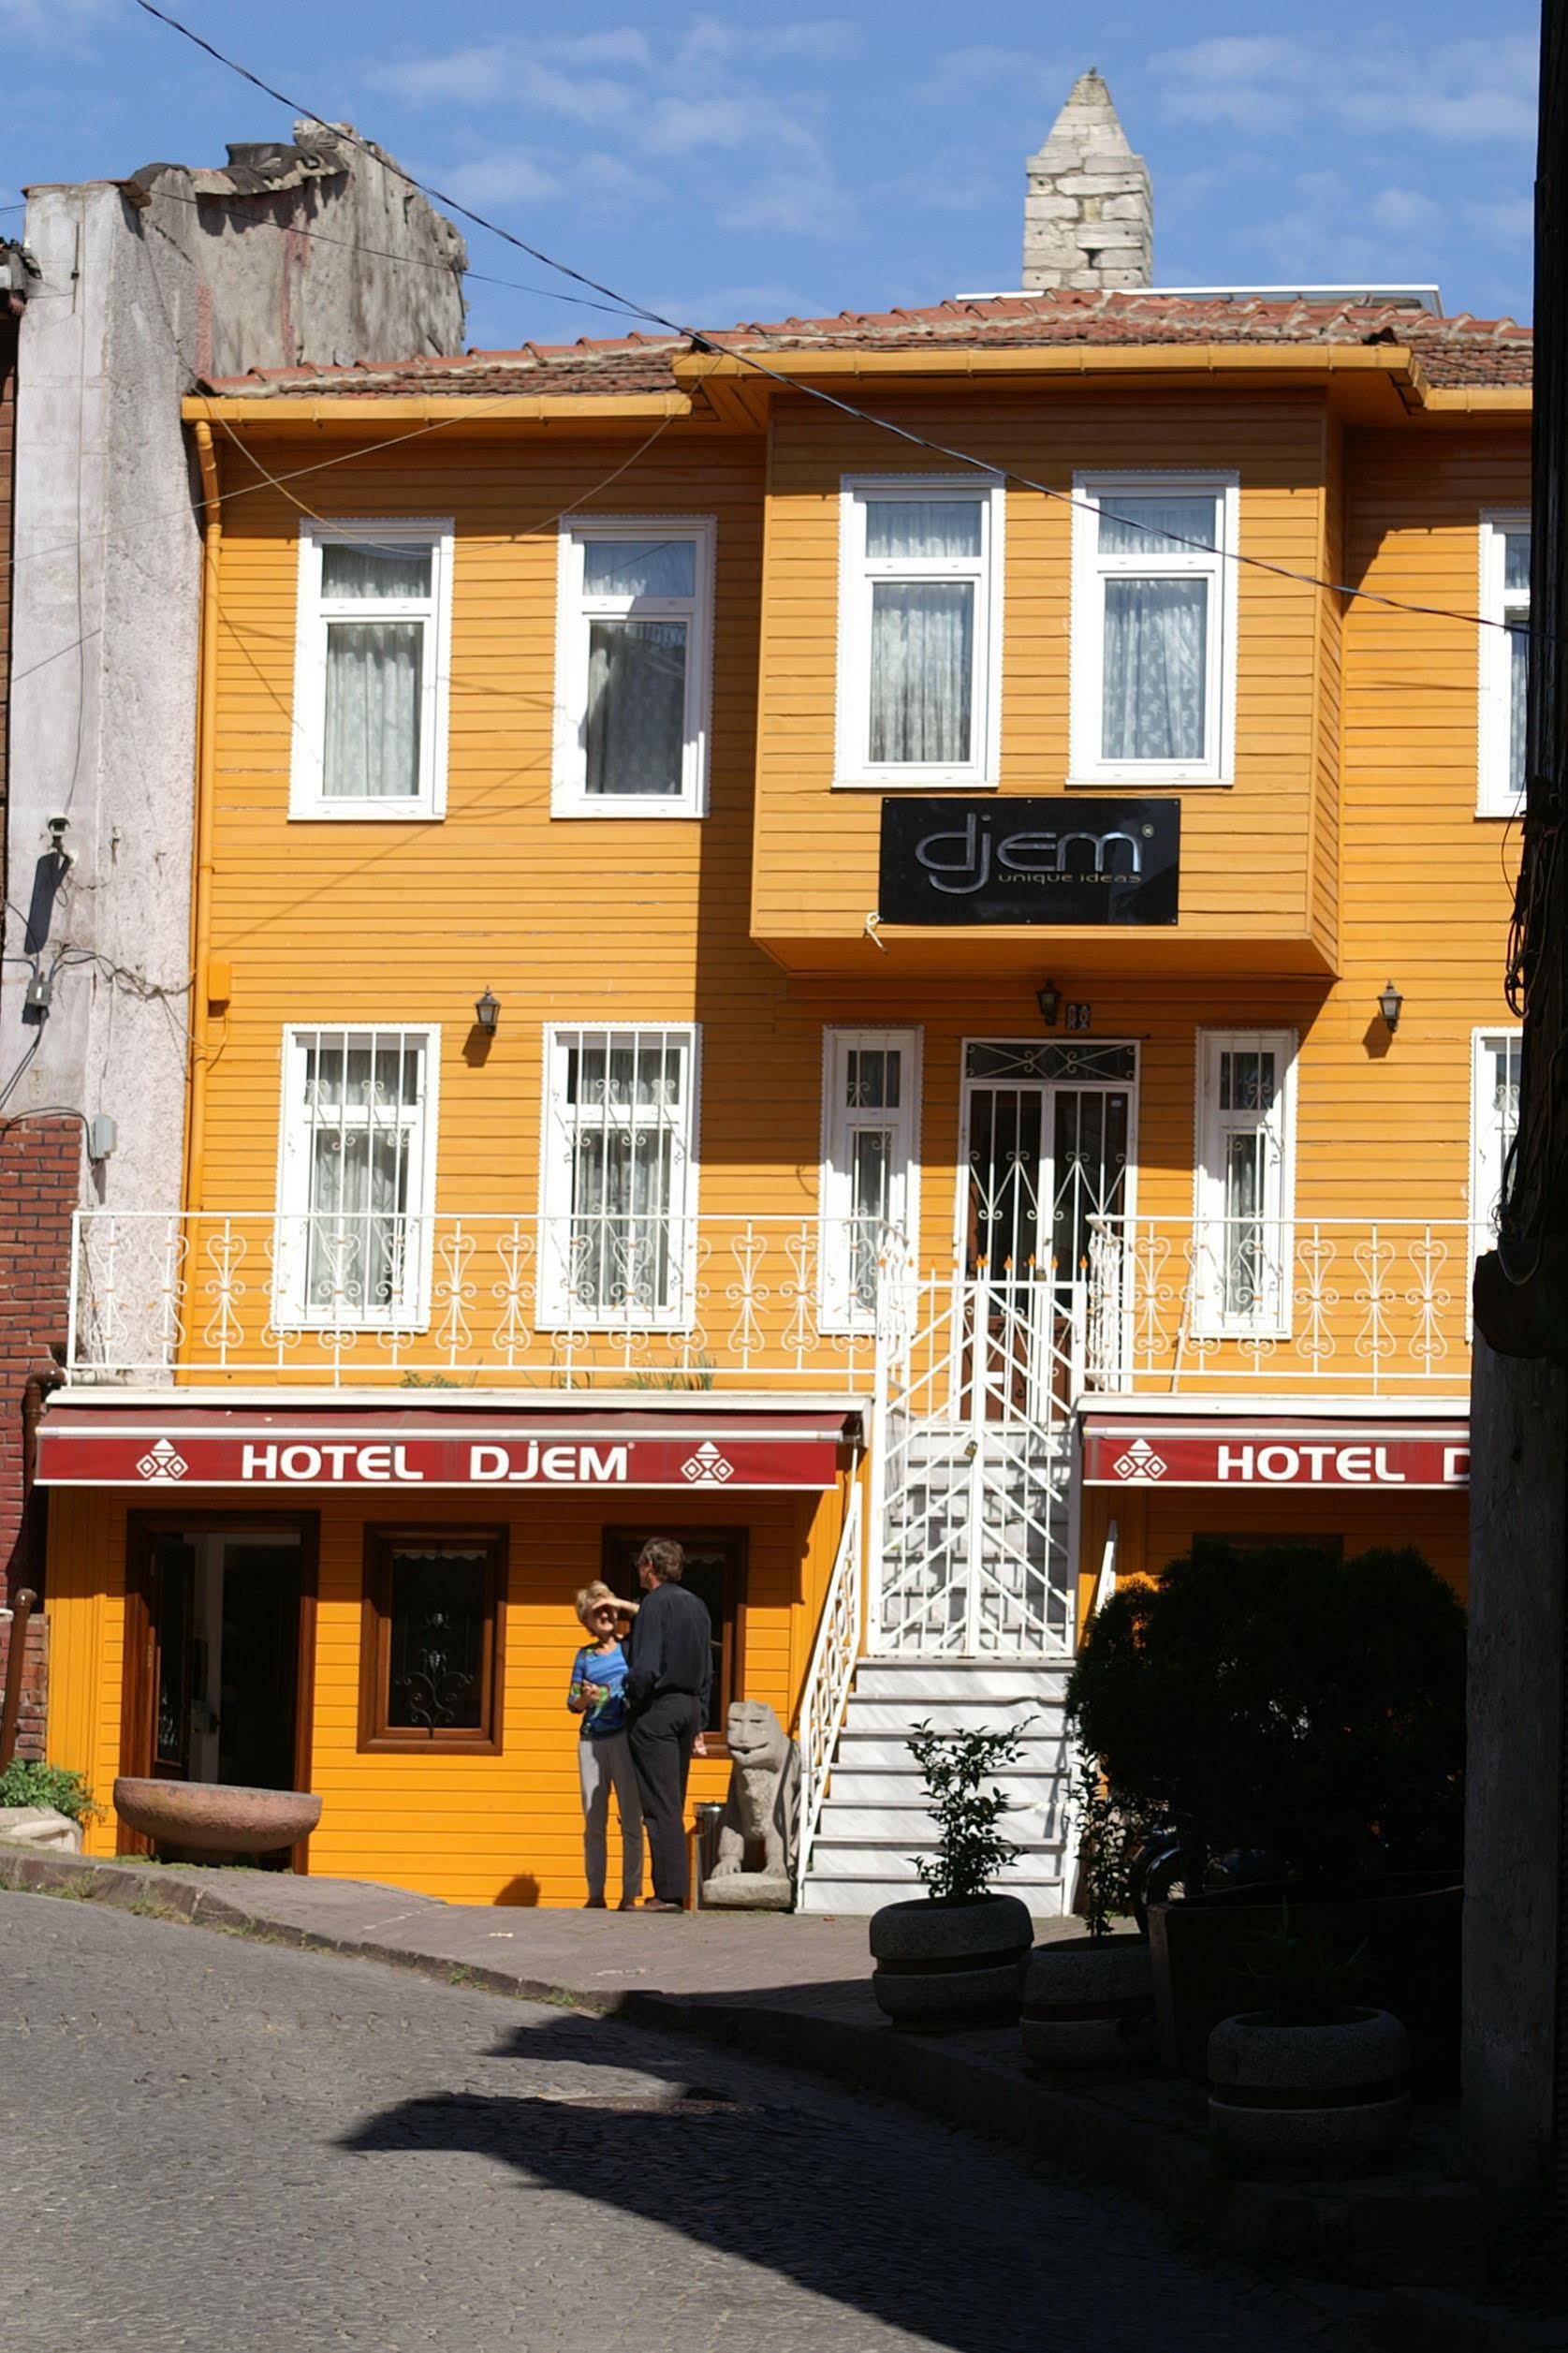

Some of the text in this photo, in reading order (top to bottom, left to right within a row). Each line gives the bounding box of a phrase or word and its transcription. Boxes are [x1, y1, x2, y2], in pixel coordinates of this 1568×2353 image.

[998, 873, 1142, 885] unique ideas
[242, 1445, 424, 1480] HOTEL
[1217, 1445, 1405, 1481] HOTEL
